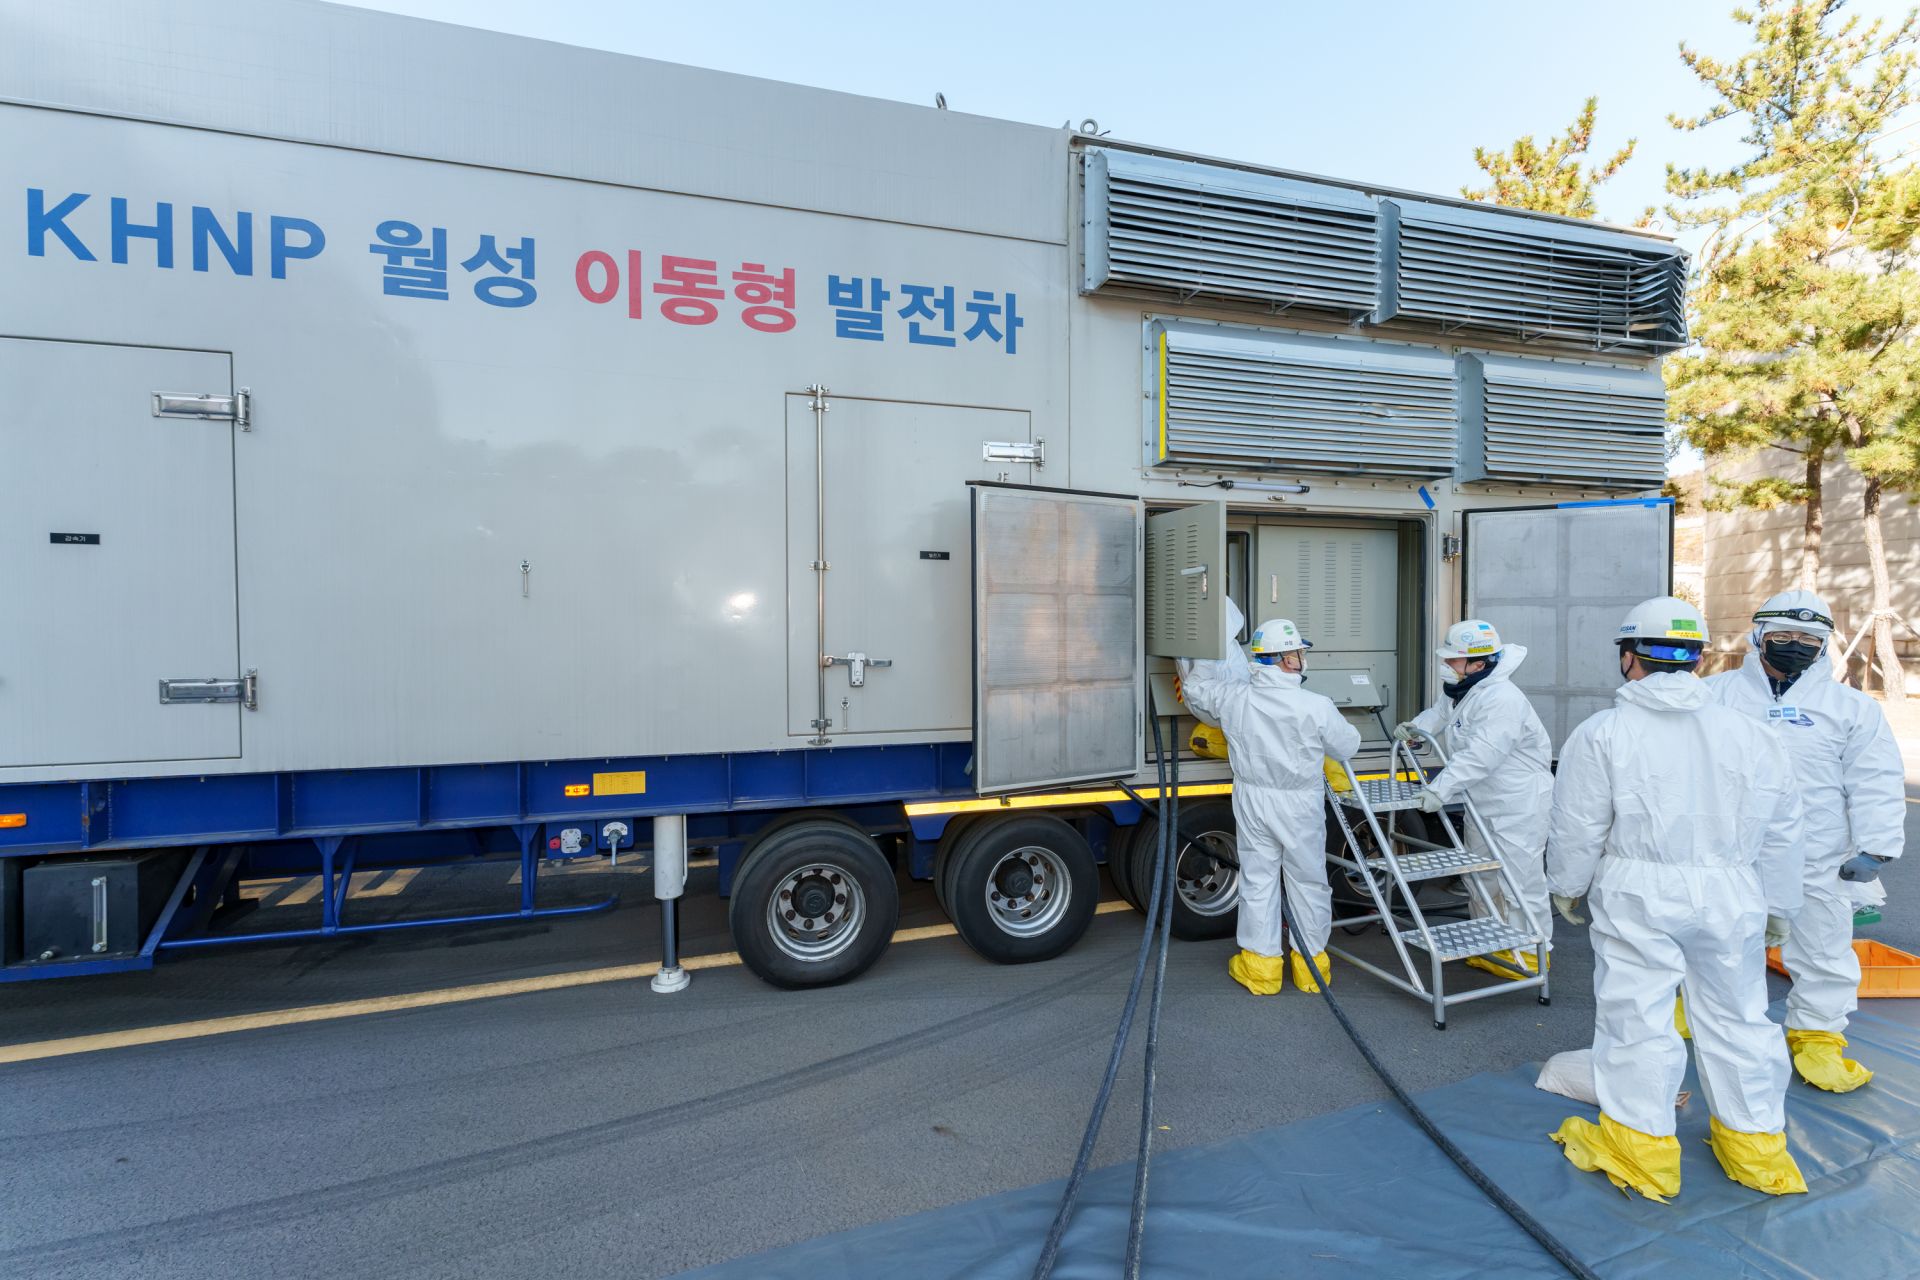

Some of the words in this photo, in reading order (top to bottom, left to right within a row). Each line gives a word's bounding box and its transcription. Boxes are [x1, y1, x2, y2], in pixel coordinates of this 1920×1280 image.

[25, 187, 326, 280] KHNP
[369, 220, 539, 308] 월성
[575, 250, 797, 333] 이동형
[827, 273, 1025, 355] 발전차
